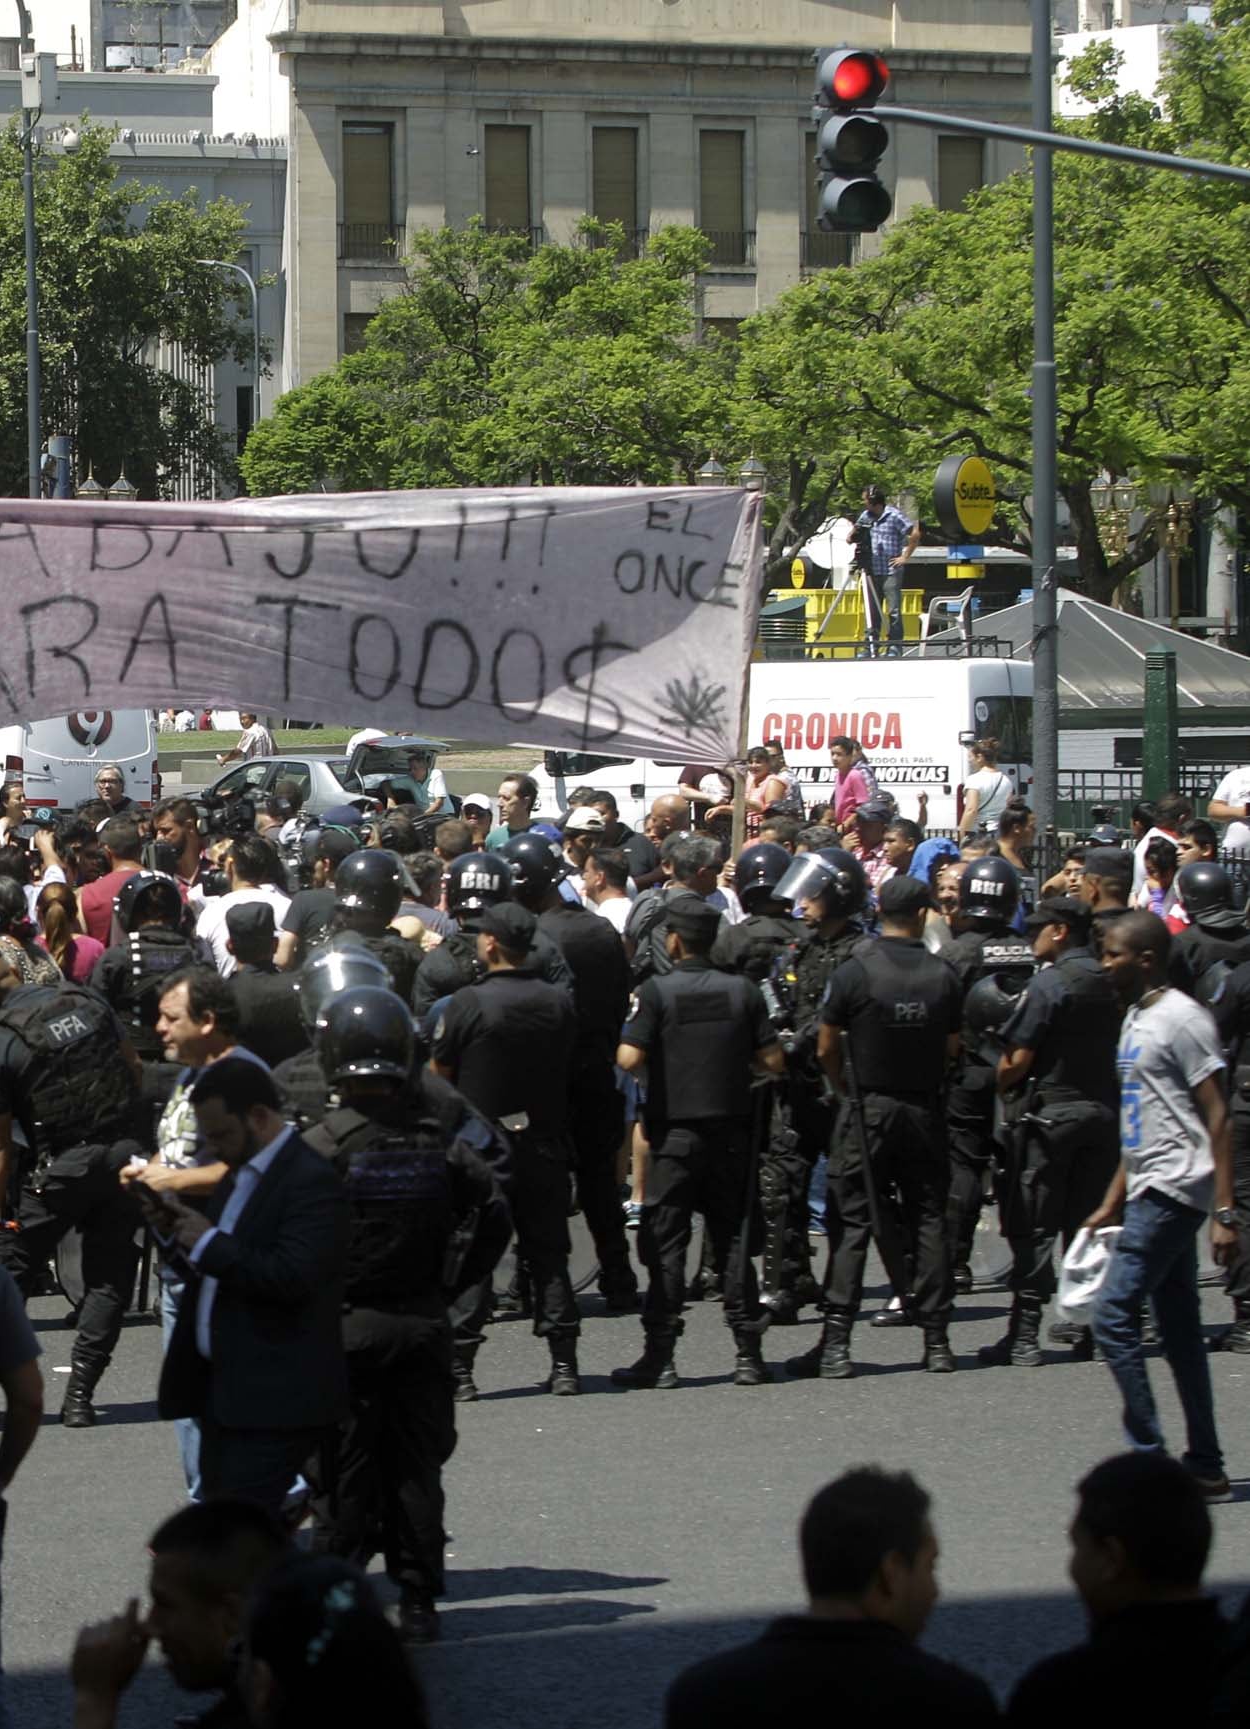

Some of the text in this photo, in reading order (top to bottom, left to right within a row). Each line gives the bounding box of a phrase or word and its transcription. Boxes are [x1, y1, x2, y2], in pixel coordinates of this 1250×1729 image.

[645, 499, 714, 540] EL
[614, 549, 746, 610] ONCE
[762, 712, 903, 750] CRONICA
[875, 767, 946, 782] NOTICIAS
[460, 872, 500, 891] BRI
[970, 879, 1005, 896] BRI
[983, 945, 1033, 956] POLICIA
[895, 1002, 928, 1022] PFA
[50, 1015, 87, 1041] PFA
